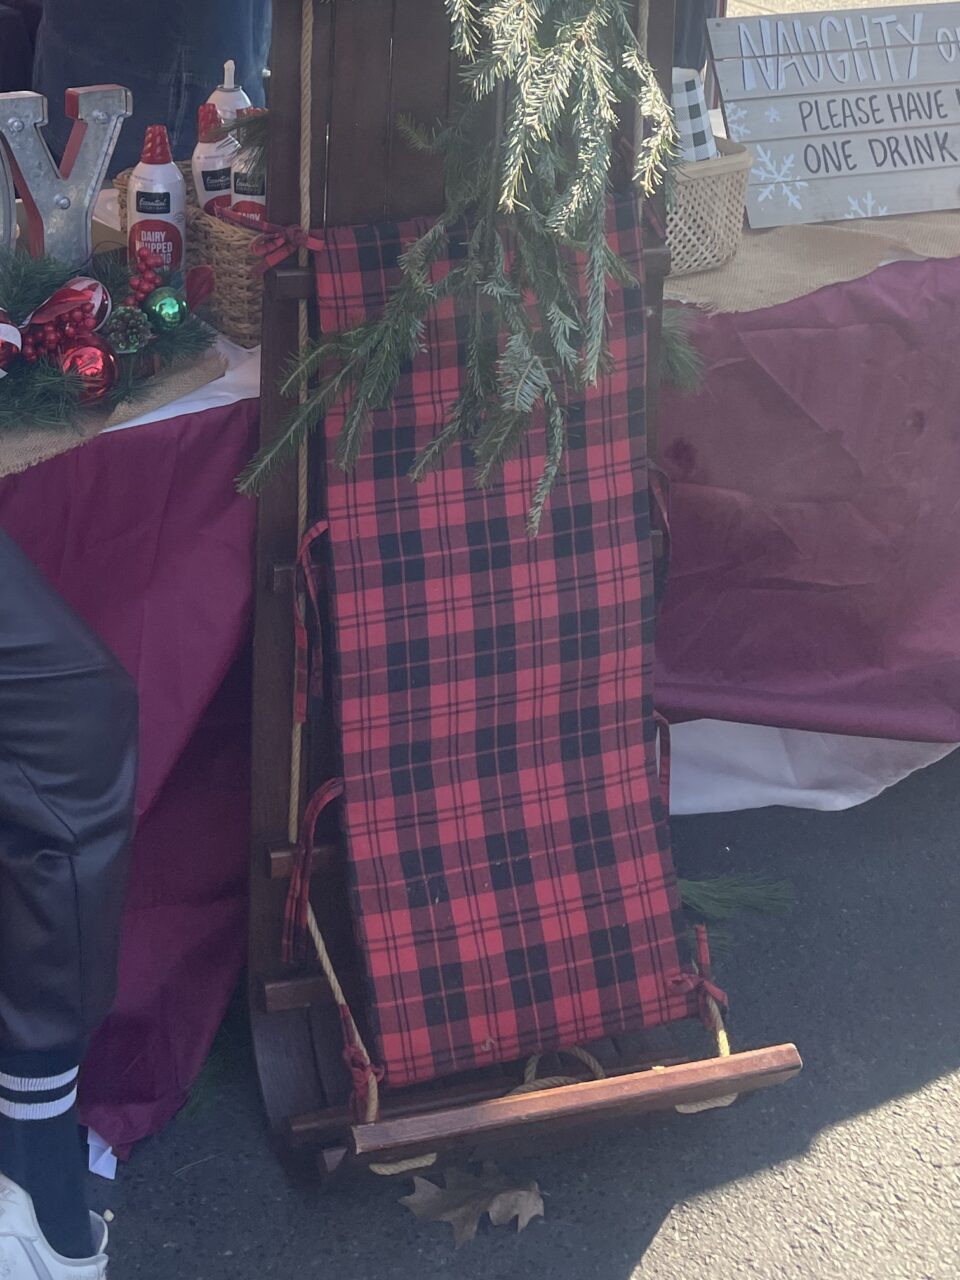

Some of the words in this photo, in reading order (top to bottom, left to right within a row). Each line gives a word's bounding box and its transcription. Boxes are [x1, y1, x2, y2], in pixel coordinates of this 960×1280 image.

[738, 12, 924, 92] NAUGHTY
[798, 94, 885, 132] PLEASE
[888, 89, 948, 123] HAVE
[803, 139, 857, 174] ONE
[868, 131, 958, 168] DRINK
[141, 230, 167, 242] DAIRY
